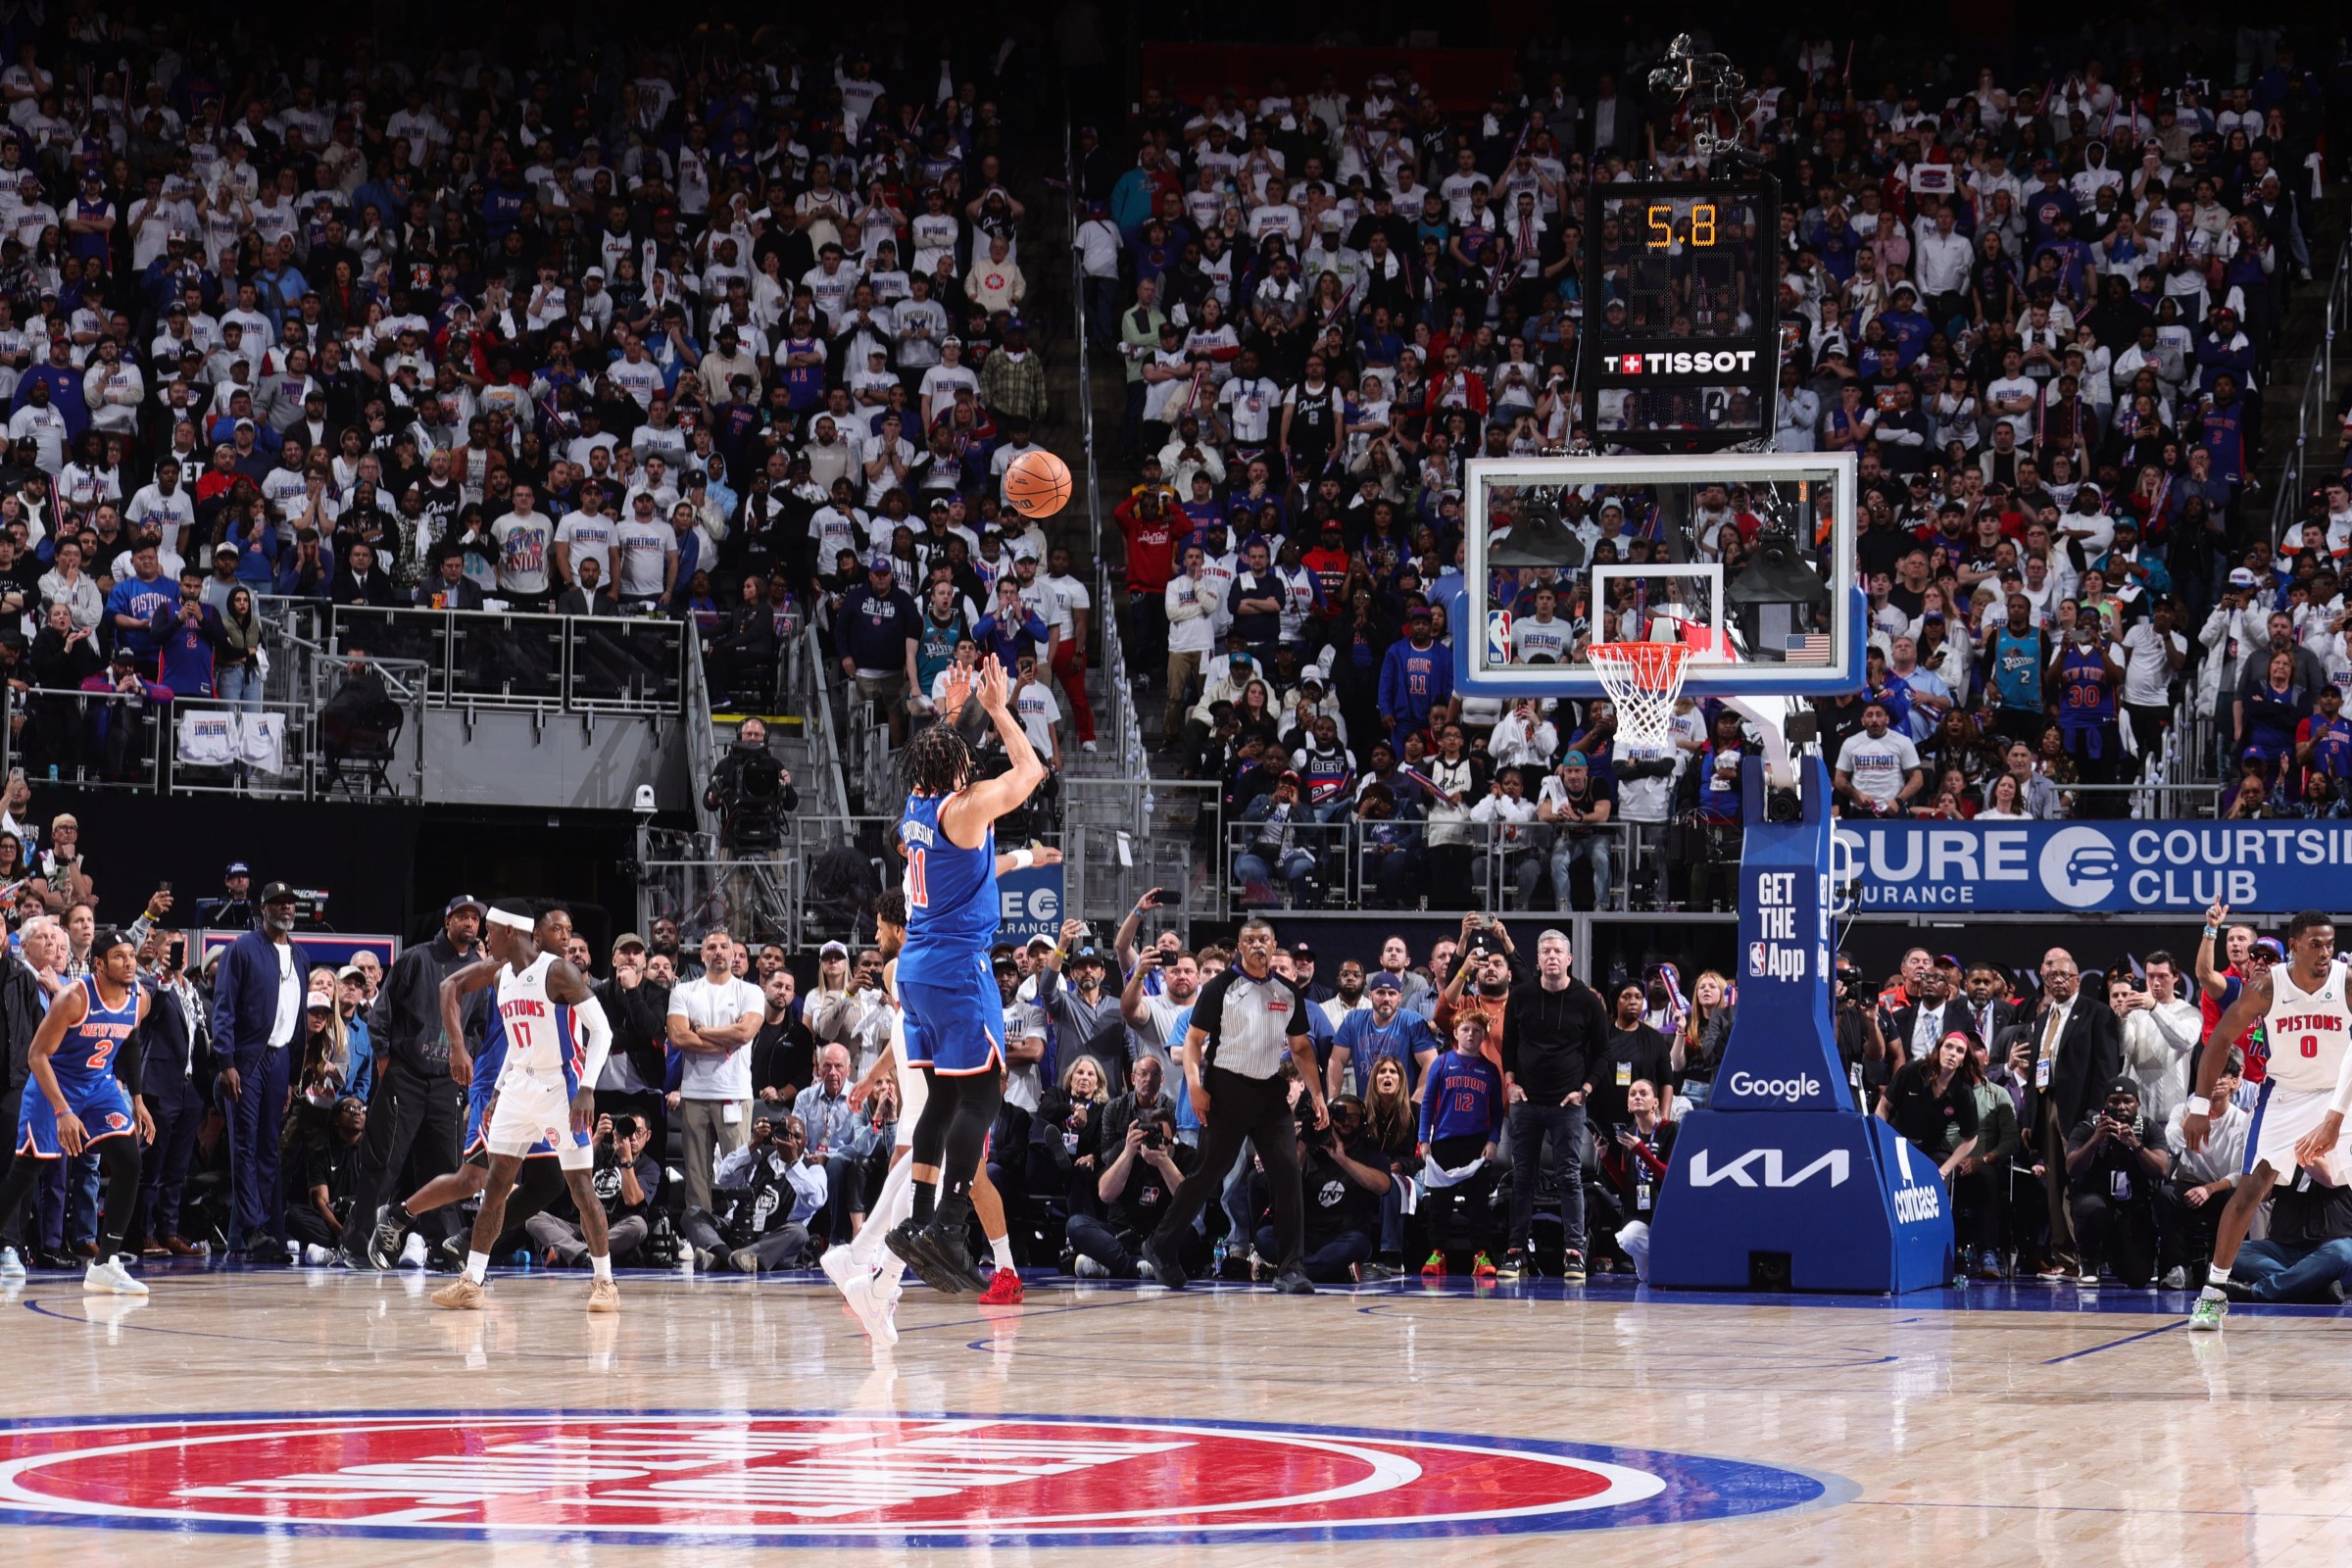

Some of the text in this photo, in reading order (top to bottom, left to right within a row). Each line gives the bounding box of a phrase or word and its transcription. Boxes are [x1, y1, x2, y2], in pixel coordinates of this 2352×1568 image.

[1648, 204, 1716, 247] 5.8
[904, 310, 935, 324] MICHIGAN
[1645, 351, 1756, 373] TISSOT
[1298, 399, 1327, 416] Detroit
[1308, 411, 1318, 425] 2
[2212, 431, 2223, 446] 2
[426, 501, 456, 516] Detroit
[576, 529, 608, 540] DEEETROIT
[626, 537, 660, 549] DEEETROIT
[1194, 530, 1202, 544] 2
[186, 632, 198, 649] 2
[1525, 634, 1561, 648] DEEETROIT
[924, 642, 954, 657] PISTO
[1490, 652, 1502, 662] NBA
[1410, 675, 1426, 695] 11
[2021, 670, 2031, 684] 2
[2068, 684, 2100, 708] 30
[2330, 742, 2340, 754] 3
[1311, 760, 1342, 773] DET
[1854, 754, 1893, 766] DEEETROIT
[902, 823, 939, 850] BRUNSON
[907, 846, 929, 908] 11
[1759, 872, 1796, 906] GET
[2128, 870, 2258, 905] CLUB
[1758, 907, 1796, 940] THE
[1767, 942, 1805, 983] App
[499, 999, 547, 1022] PISTONS
[79, 1023, 111, 1038] NEW
[2276, 1015, 2342, 1035] PISTONS
[513, 1021, 532, 1050] 17
[2300, 1035, 2318, 1058] 0
[85, 1040, 115, 1072] 2
[1446, 1078, 1488, 1096] DETROIT
[1730, 1070, 1821, 1102] Google
[1454, 1095, 1474, 1112] 12
[1893, 1179, 1940, 1225] coinbase
